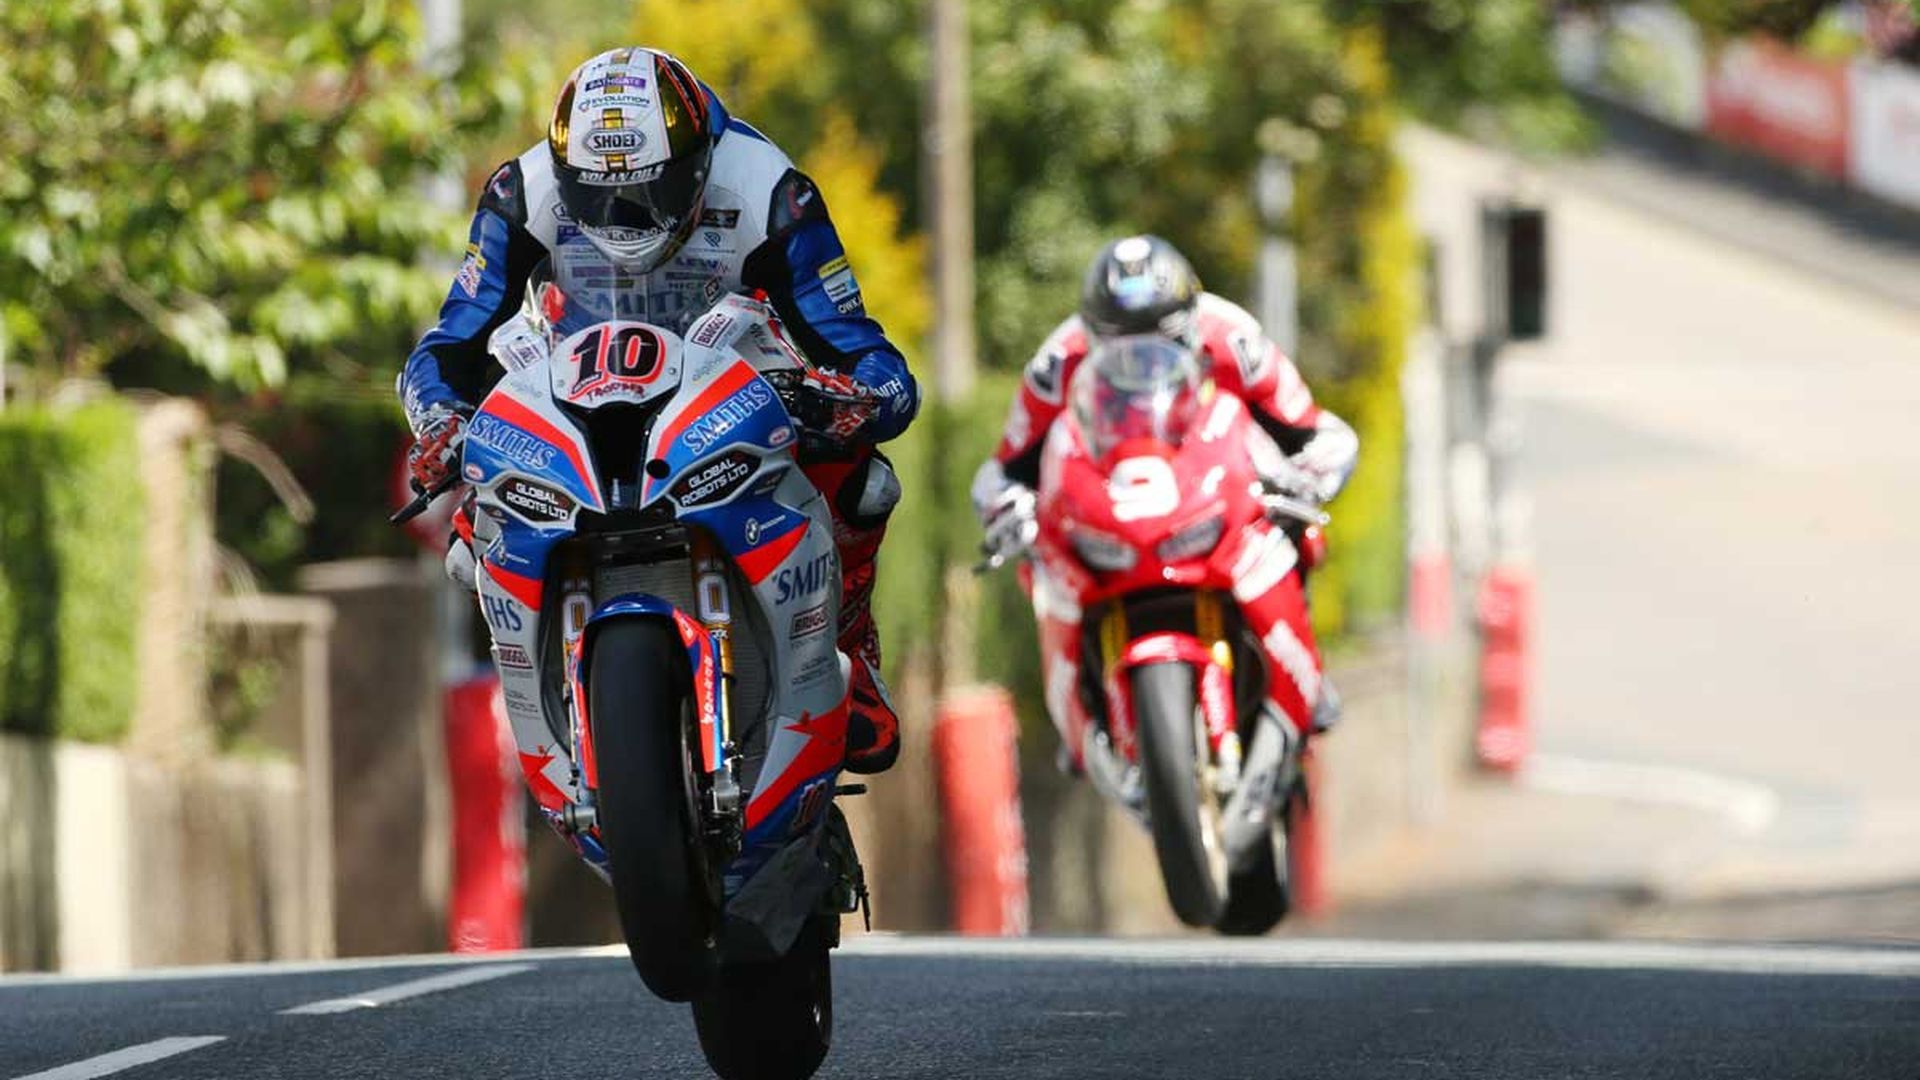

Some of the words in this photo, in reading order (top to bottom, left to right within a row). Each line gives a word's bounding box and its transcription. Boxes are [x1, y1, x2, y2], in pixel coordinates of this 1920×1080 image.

[593, 134, 636, 149] SHOEI
[570, 325, 666, 398] 10
[682, 381, 772, 456] SMITHS
[471, 414, 557, 470] SMITHS
[515, 482, 559, 506] GLOBAL
[681, 474, 728, 507] ROBOTS
[728, 463, 749, 482] LTD
[688, 458, 736, 488] GLOBAL
[1108, 455, 1180, 522] 9
[506, 491, 548, 515] ROBOTS
[549, 507, 569, 520] LTD
